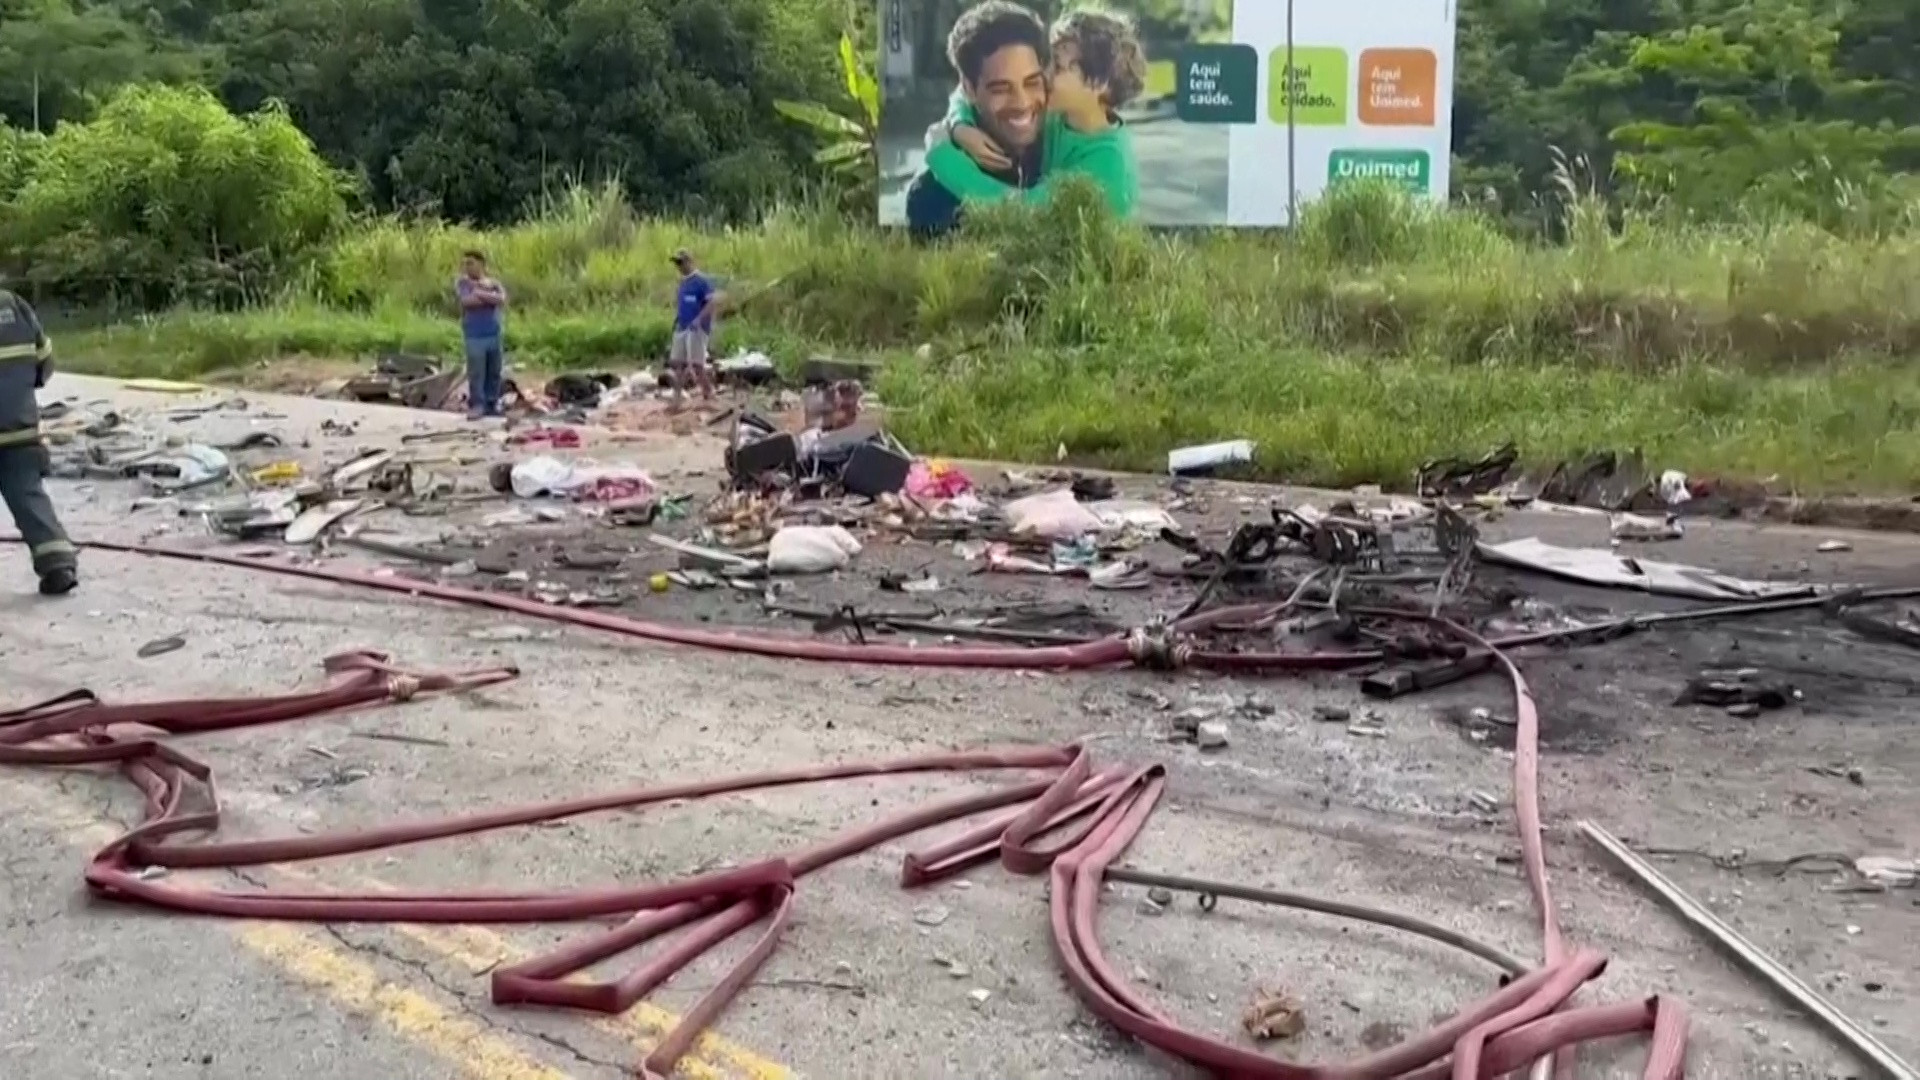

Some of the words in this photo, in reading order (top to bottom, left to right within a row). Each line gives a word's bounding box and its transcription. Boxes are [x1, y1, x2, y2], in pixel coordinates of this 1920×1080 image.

[1190, 62, 1220, 80] Aqui
[1371, 66, 1401, 82] Aqui
[1190, 79, 1216, 90] tem
[1371, 82, 1396, 93] tem
[1189, 90, 1233, 105] saúde.
[1370, 94, 1424, 108] Unimed.
[1338, 159, 1420, 178] Unimed
